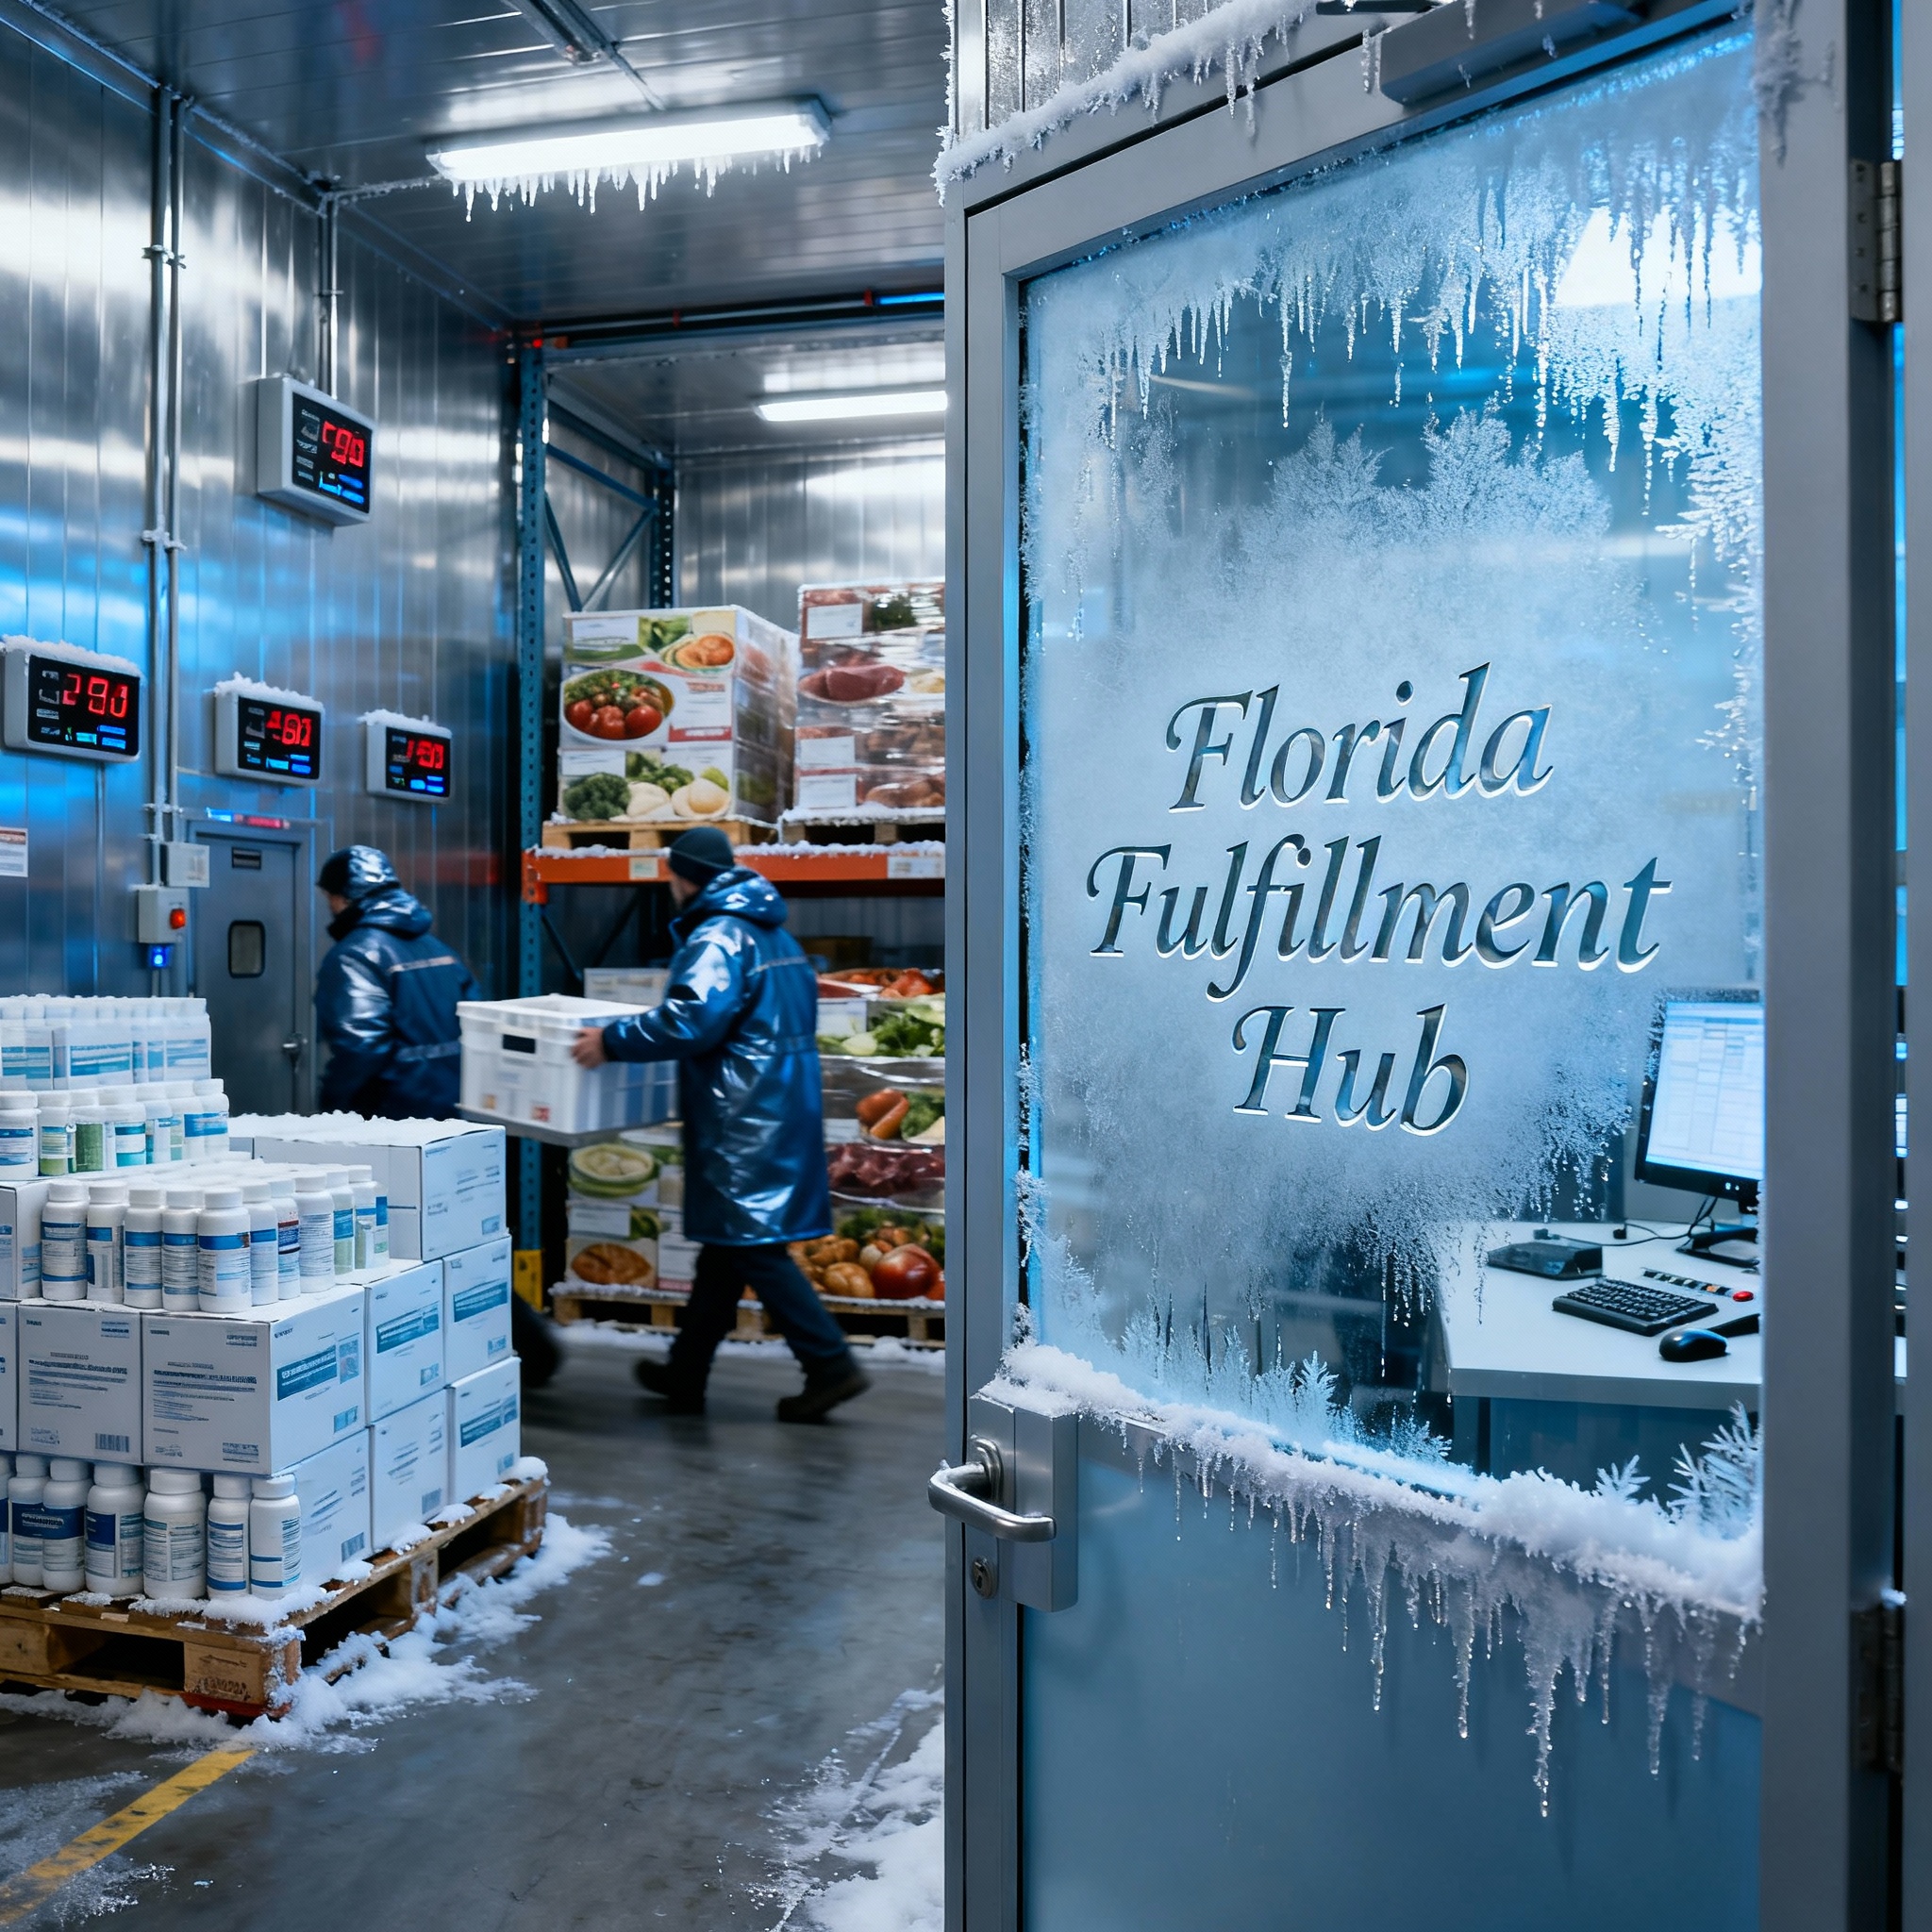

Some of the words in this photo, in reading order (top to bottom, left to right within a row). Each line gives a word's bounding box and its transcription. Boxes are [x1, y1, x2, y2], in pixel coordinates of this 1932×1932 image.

[1166, 662, 1553, 813] Florida
[1087, 834, 1673, 1002] Fulfillment
[1233, 1004, 1469, 1136] Hub
